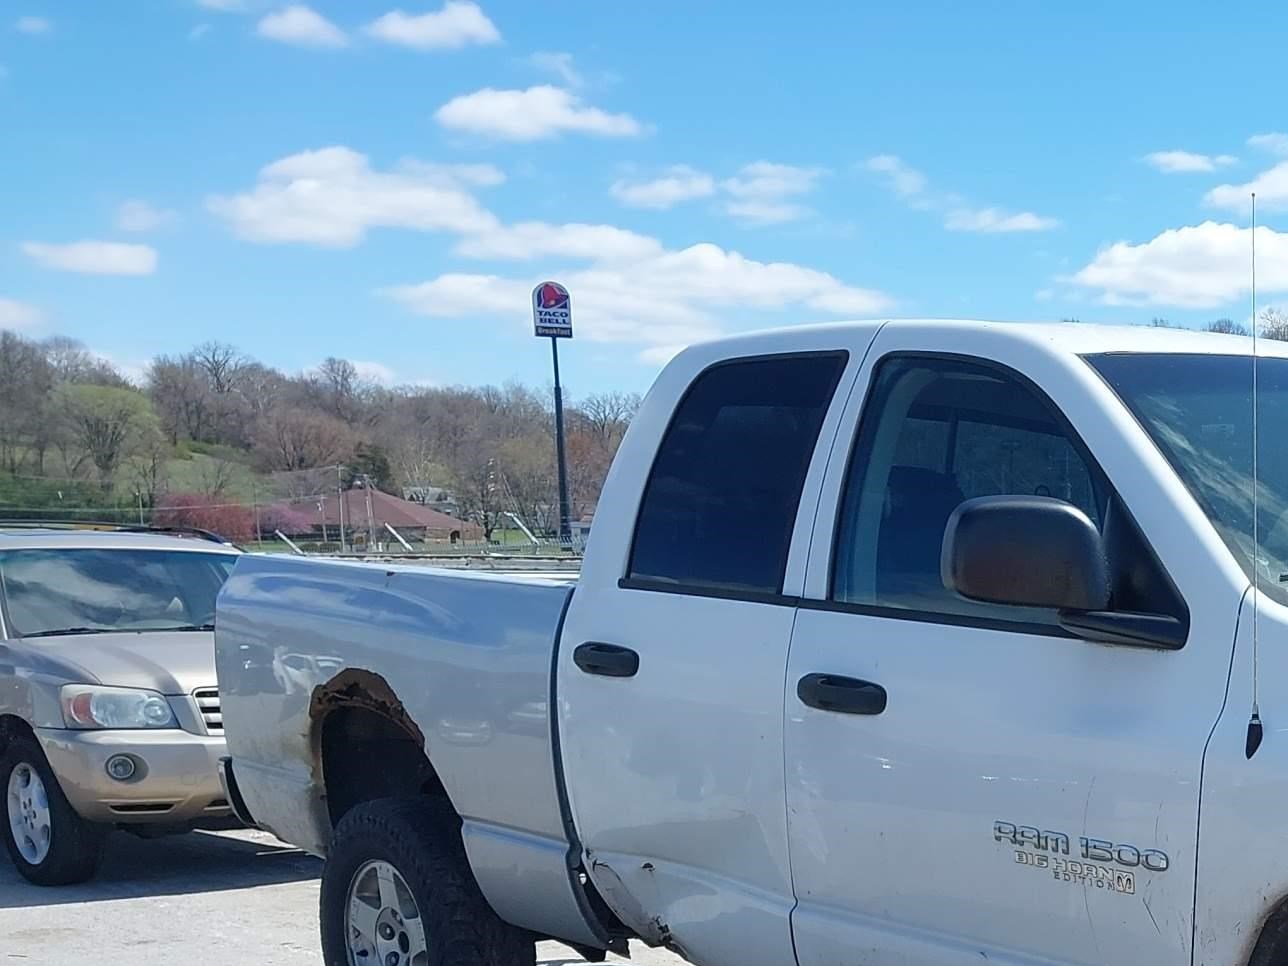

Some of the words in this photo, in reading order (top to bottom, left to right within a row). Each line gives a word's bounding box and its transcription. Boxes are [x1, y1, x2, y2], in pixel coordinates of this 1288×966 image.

[993, 820, 1070, 855] RAM
[1079, 836, 1169, 872] 1500
[1014, 850, 1049, 868] BIG
[1052, 857, 1113, 881] HORN
[1053, 871, 1114, 890] EDITION
